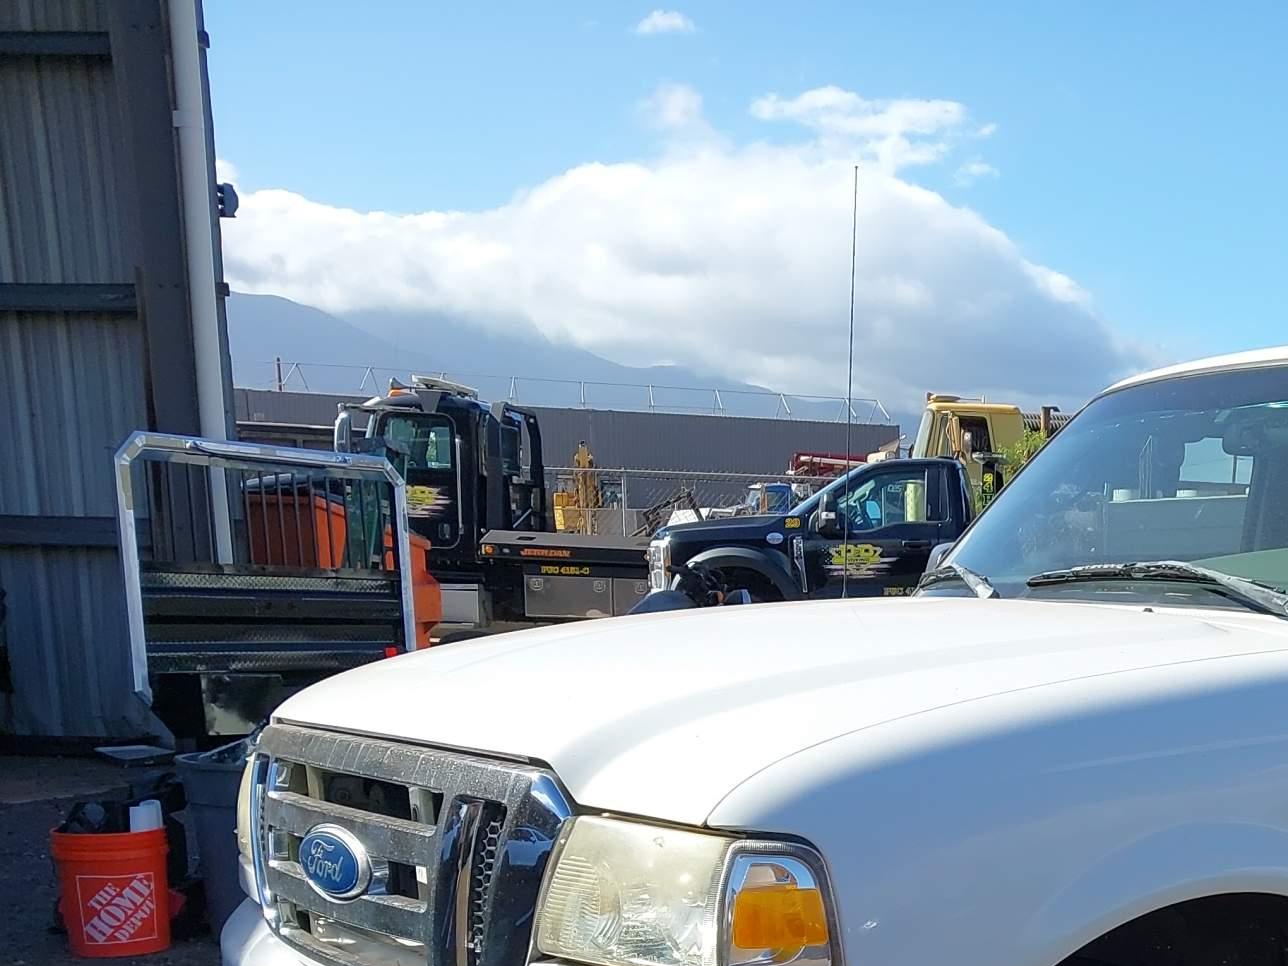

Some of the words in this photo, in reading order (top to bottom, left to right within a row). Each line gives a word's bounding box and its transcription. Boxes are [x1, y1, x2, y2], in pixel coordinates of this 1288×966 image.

[307, 839, 344, 883] Ford
[85, 875, 153, 943] HOME
[88, 882, 121, 910] THE
[114, 897, 155, 941] DEPOT
